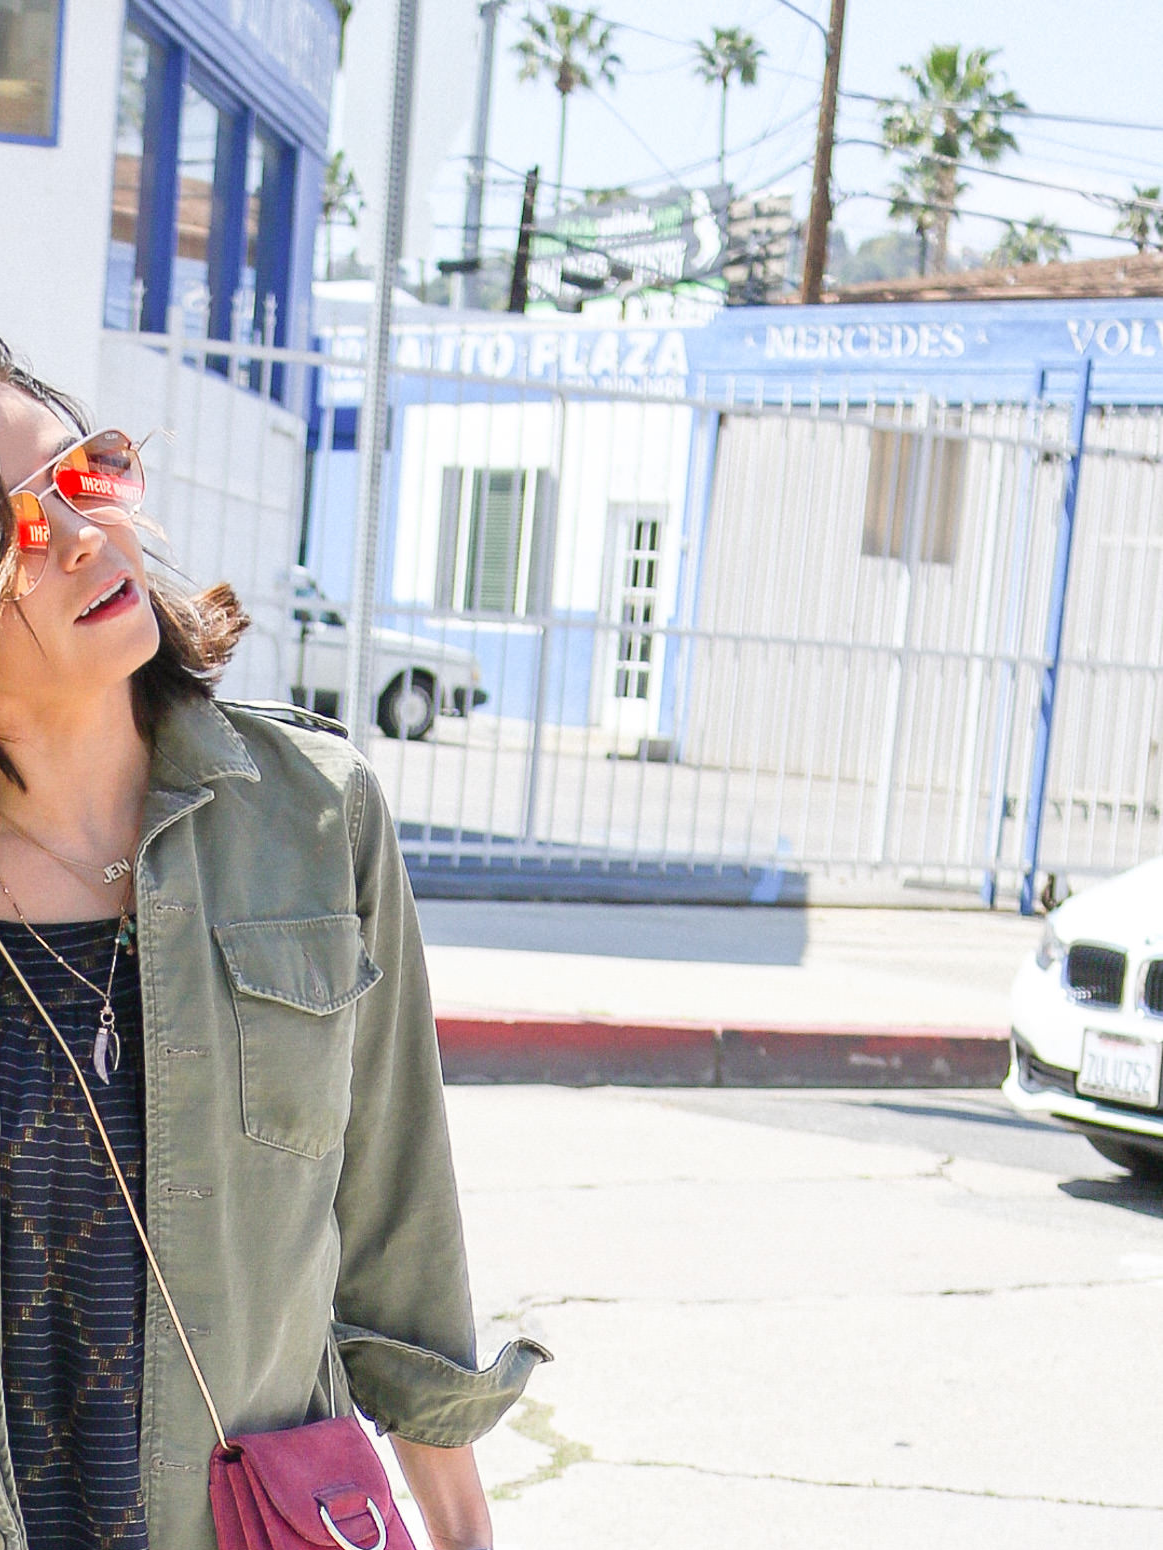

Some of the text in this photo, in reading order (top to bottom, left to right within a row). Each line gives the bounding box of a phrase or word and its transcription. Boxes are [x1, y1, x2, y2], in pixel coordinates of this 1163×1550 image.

[527, 330, 689, 377] PLAZA
[764, 321, 966, 359] MERCEDES
[1066, 318, 1163, 356] VOL
[102, 857, 131, 885] JEN
